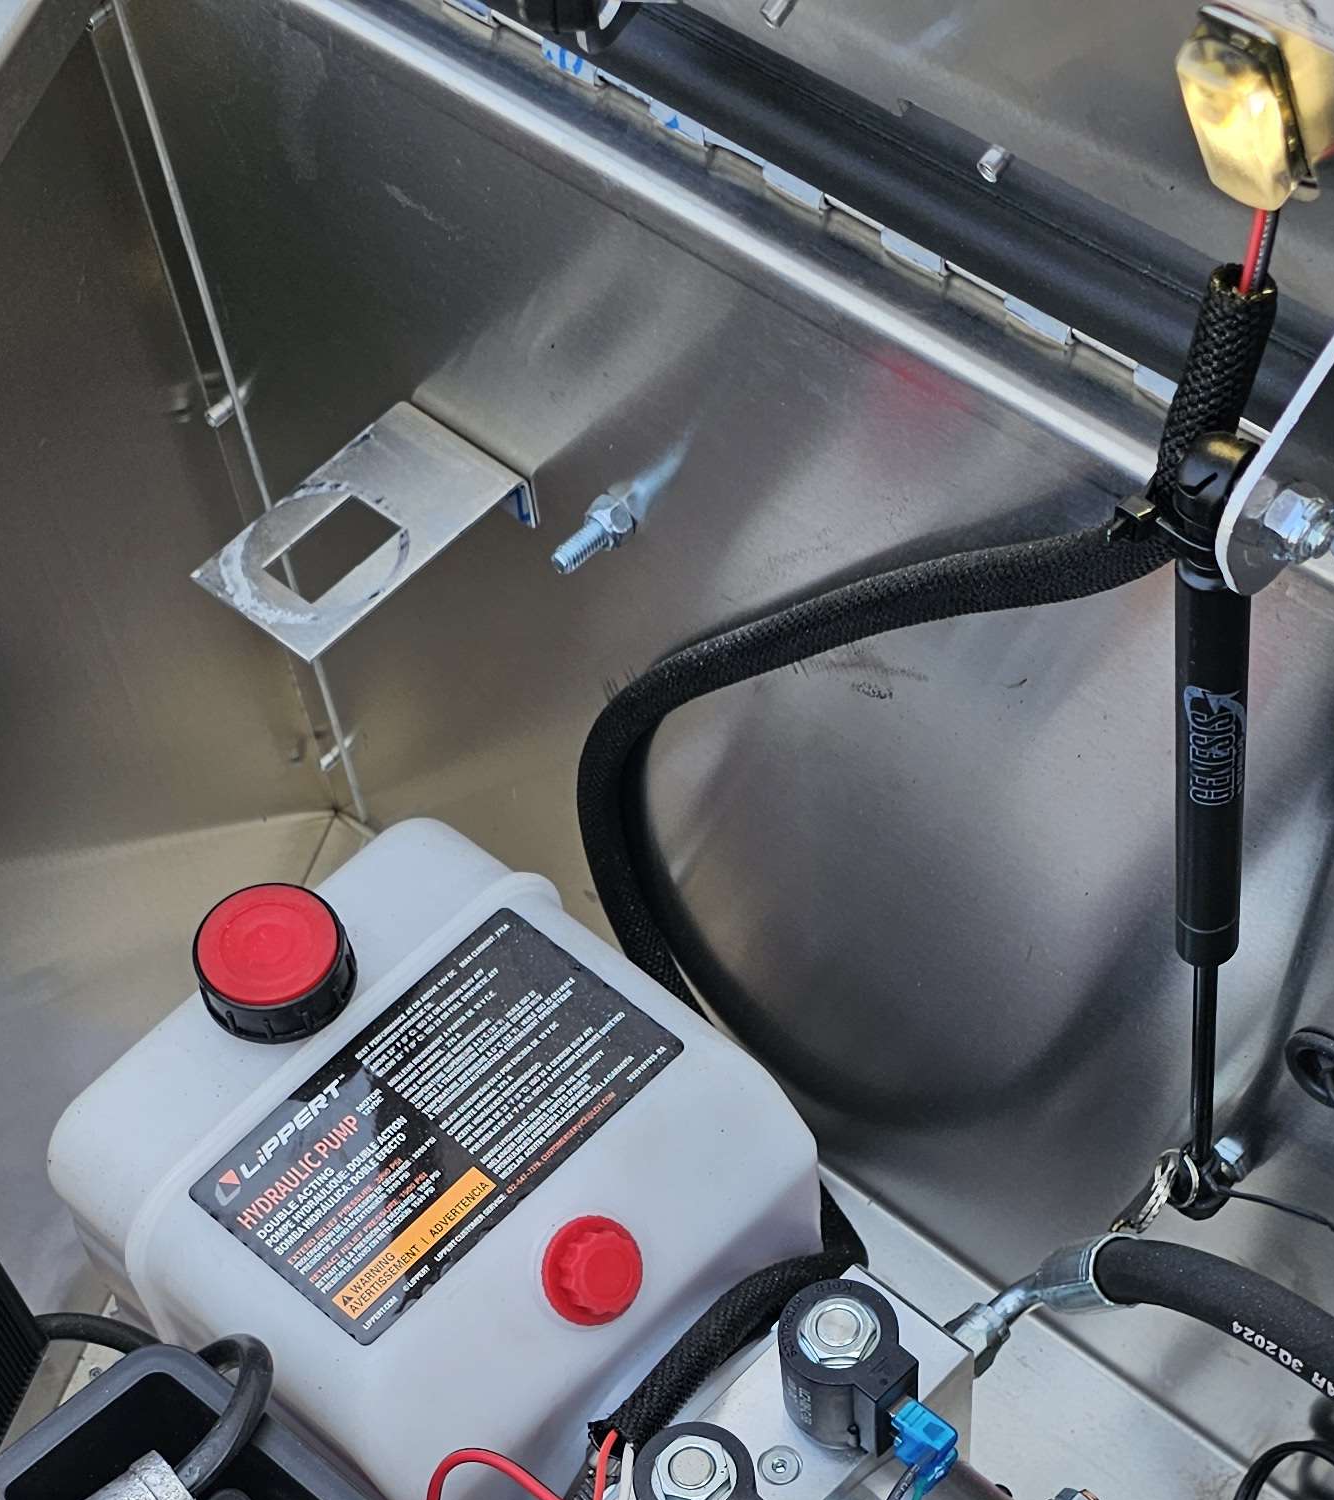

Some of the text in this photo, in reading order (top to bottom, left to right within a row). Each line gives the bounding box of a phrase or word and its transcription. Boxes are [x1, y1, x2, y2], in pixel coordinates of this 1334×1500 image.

[1189, 711, 1236, 806] GENESIS
[234, 1113, 364, 1231] HYDRAULIC PUMP
[255, 1165, 336, 1240] DOUBLE ACTING
[263, 1218, 296, 1248] POMPE
[344, 1139, 381, 1173] DOUBLE
[374, 1114, 409, 1145] ACTION
[272, 1224, 308, 1256] BOMBA
[348, 1157, 380, 1186] DOBLE
[373, 1131, 408, 1162] EFECTO
[286, 1237, 317, 1265] EXTEND
[346, 1179, 490, 1313] AVERTISSEMENT ADVERTENCIA
[349, 1251, 396, 1295] WARNING
[1227, 1318, 1306, 1373] 3Q2024
